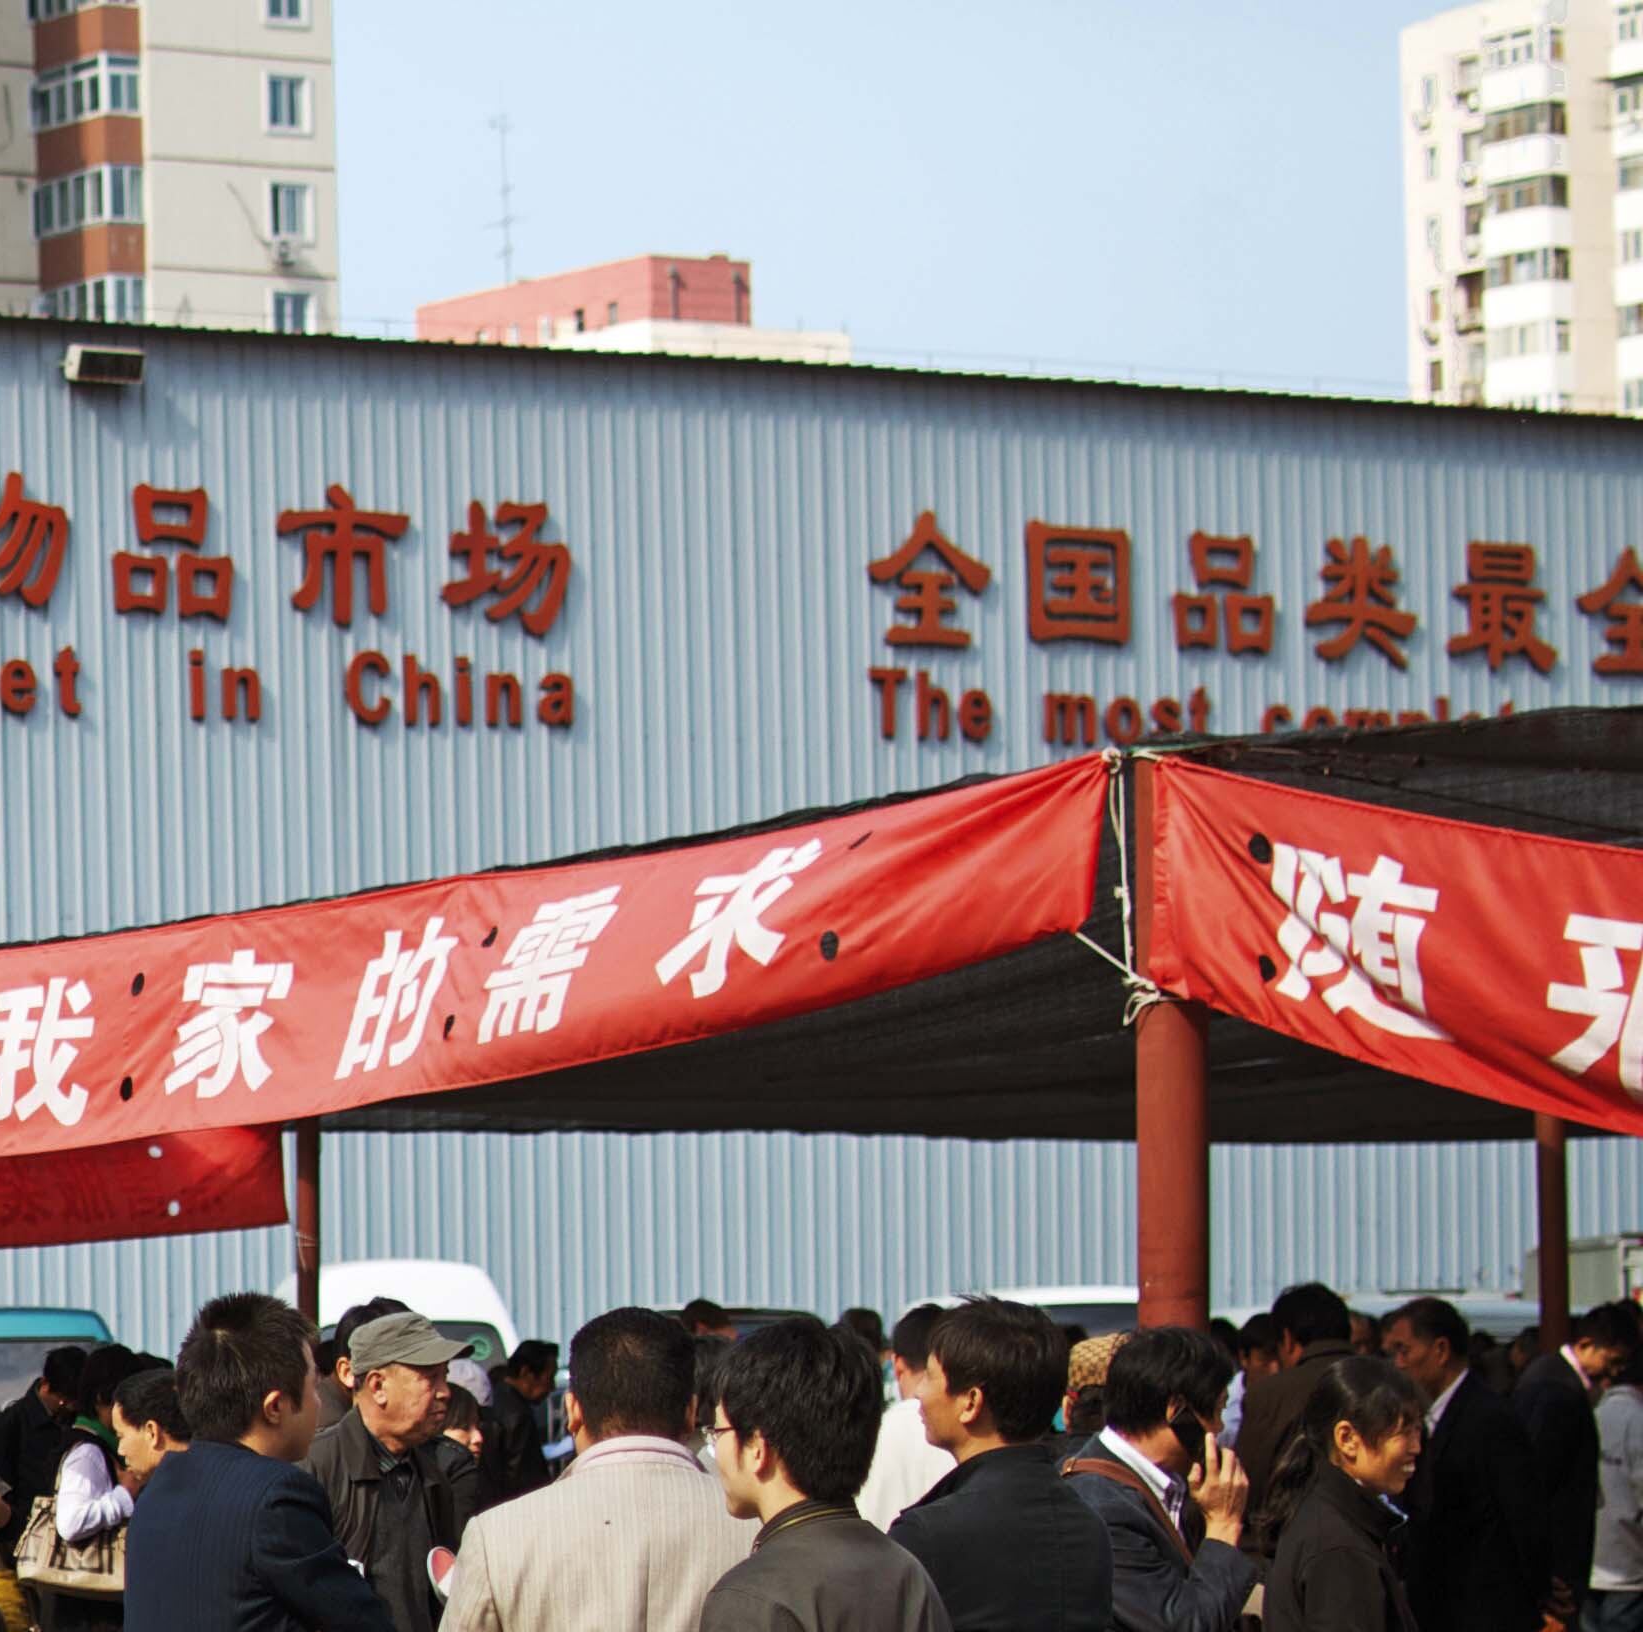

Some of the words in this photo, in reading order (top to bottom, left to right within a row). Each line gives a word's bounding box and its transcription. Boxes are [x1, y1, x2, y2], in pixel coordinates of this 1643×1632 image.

[189, 647, 263, 721] in
[345, 649, 575, 726] China
[868, 666, 993, 742] The
[1043, 686, 1211, 745] most
